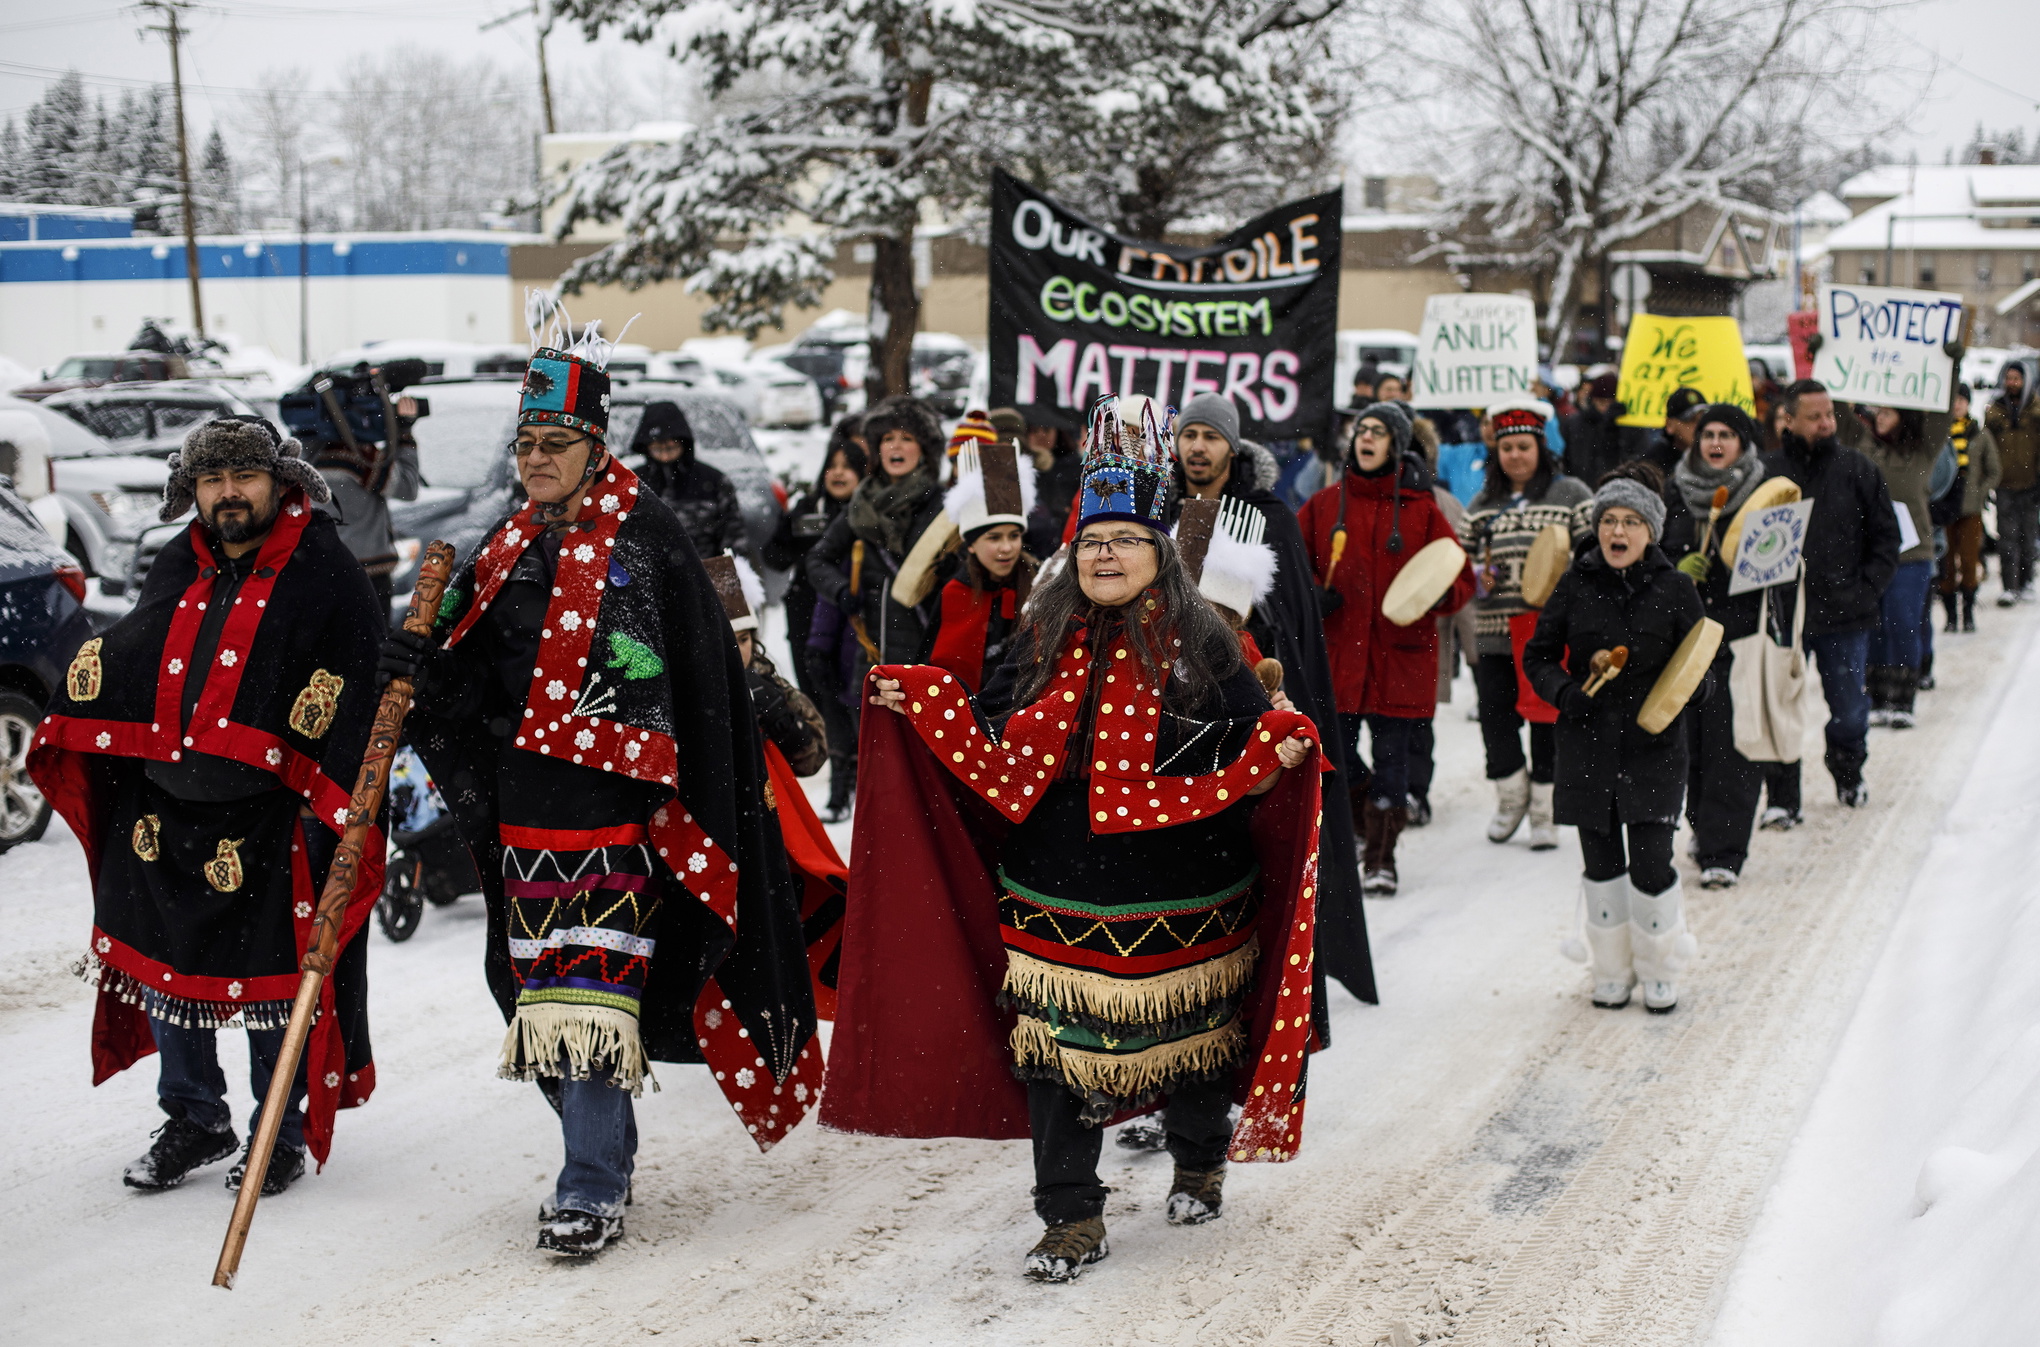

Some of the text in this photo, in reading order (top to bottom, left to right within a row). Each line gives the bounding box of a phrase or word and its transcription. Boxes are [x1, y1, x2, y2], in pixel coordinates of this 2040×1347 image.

[1432, 323, 1518, 352] ANUK
[1831, 290, 1962, 348] PROTECT
[1651, 325, 1697, 358] We
[1871, 347, 1902, 365] the
[1015, 334, 1300, 422] MATTERS
[1414, 358, 1528, 395] NUATEN
[1633, 361, 1703, 384] are
[1826, 356, 1942, 403] Yintah
[1744, 529, 1761, 553] ALL
[1763, 508, 1794, 528] EYES
